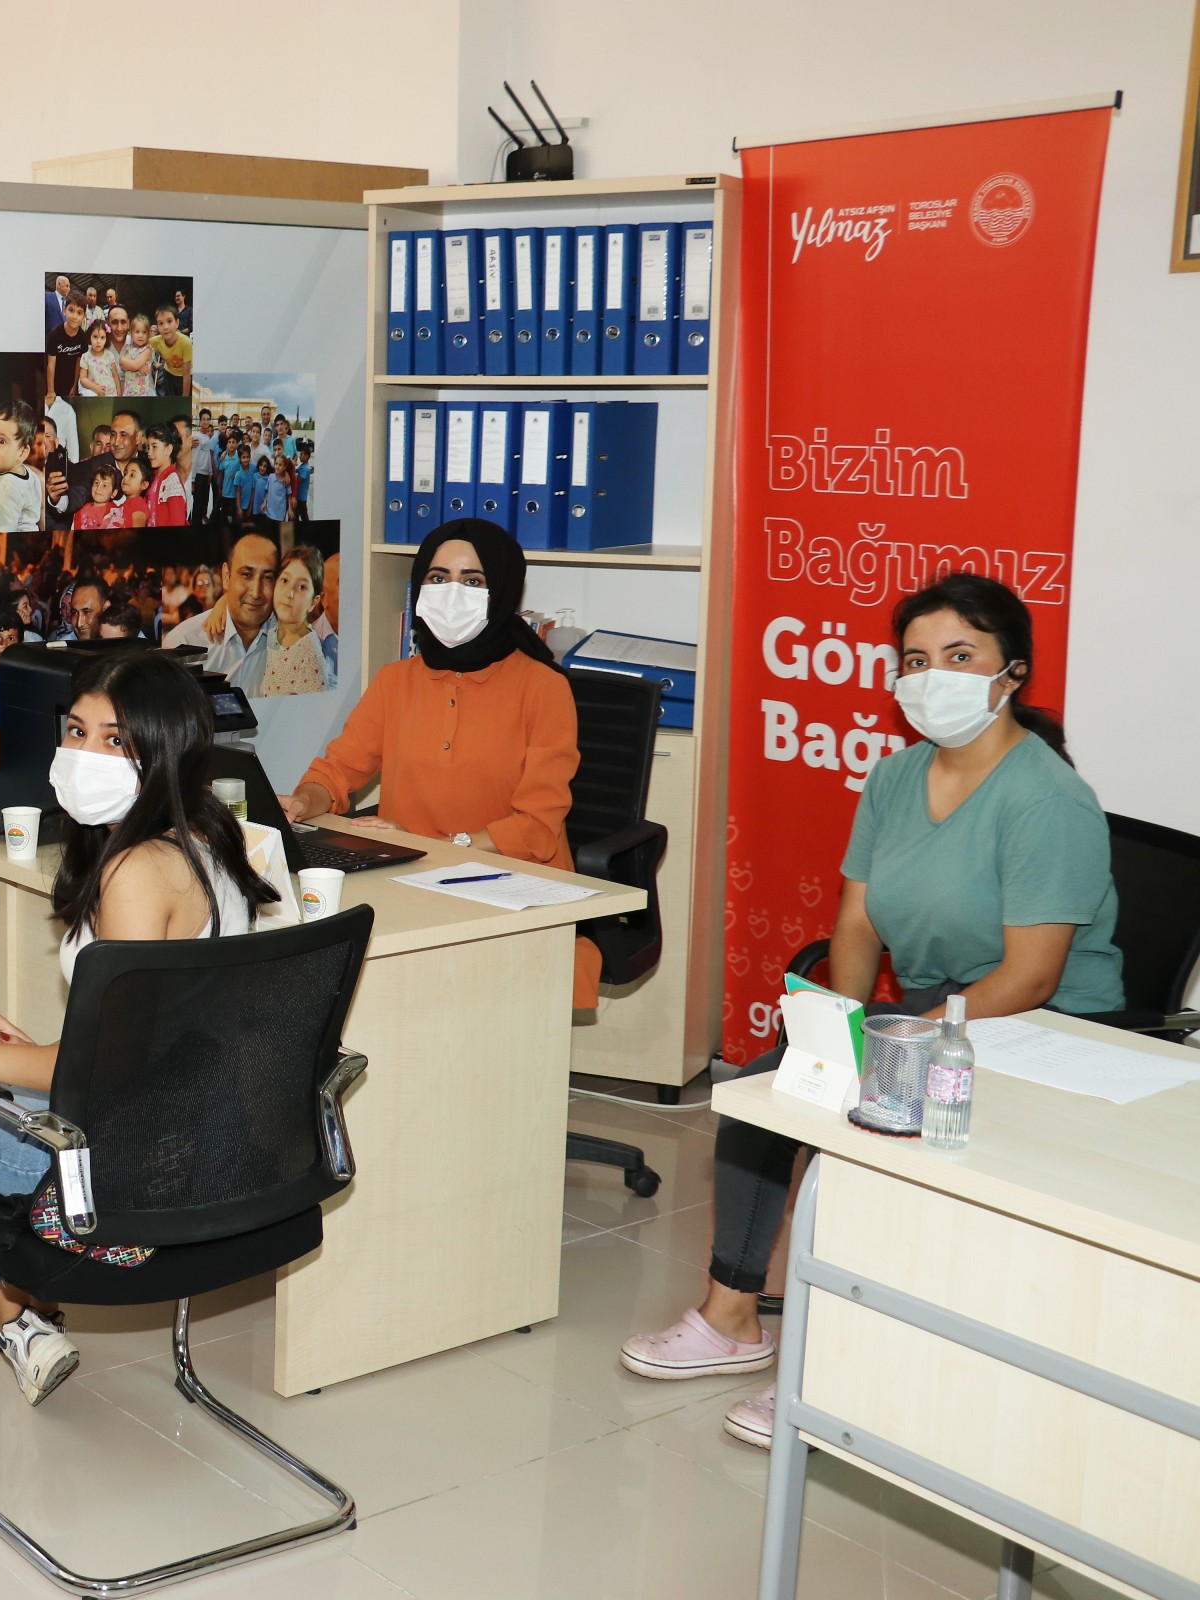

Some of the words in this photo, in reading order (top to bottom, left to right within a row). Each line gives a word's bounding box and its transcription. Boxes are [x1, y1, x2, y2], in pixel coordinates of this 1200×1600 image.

[791, 207, 892, 264] Yılmaz
[909, 199, 958, 211] TOROSLAR
[766, 427, 968, 499] Bizim
[764, 517, 1066, 607] Bağımız
